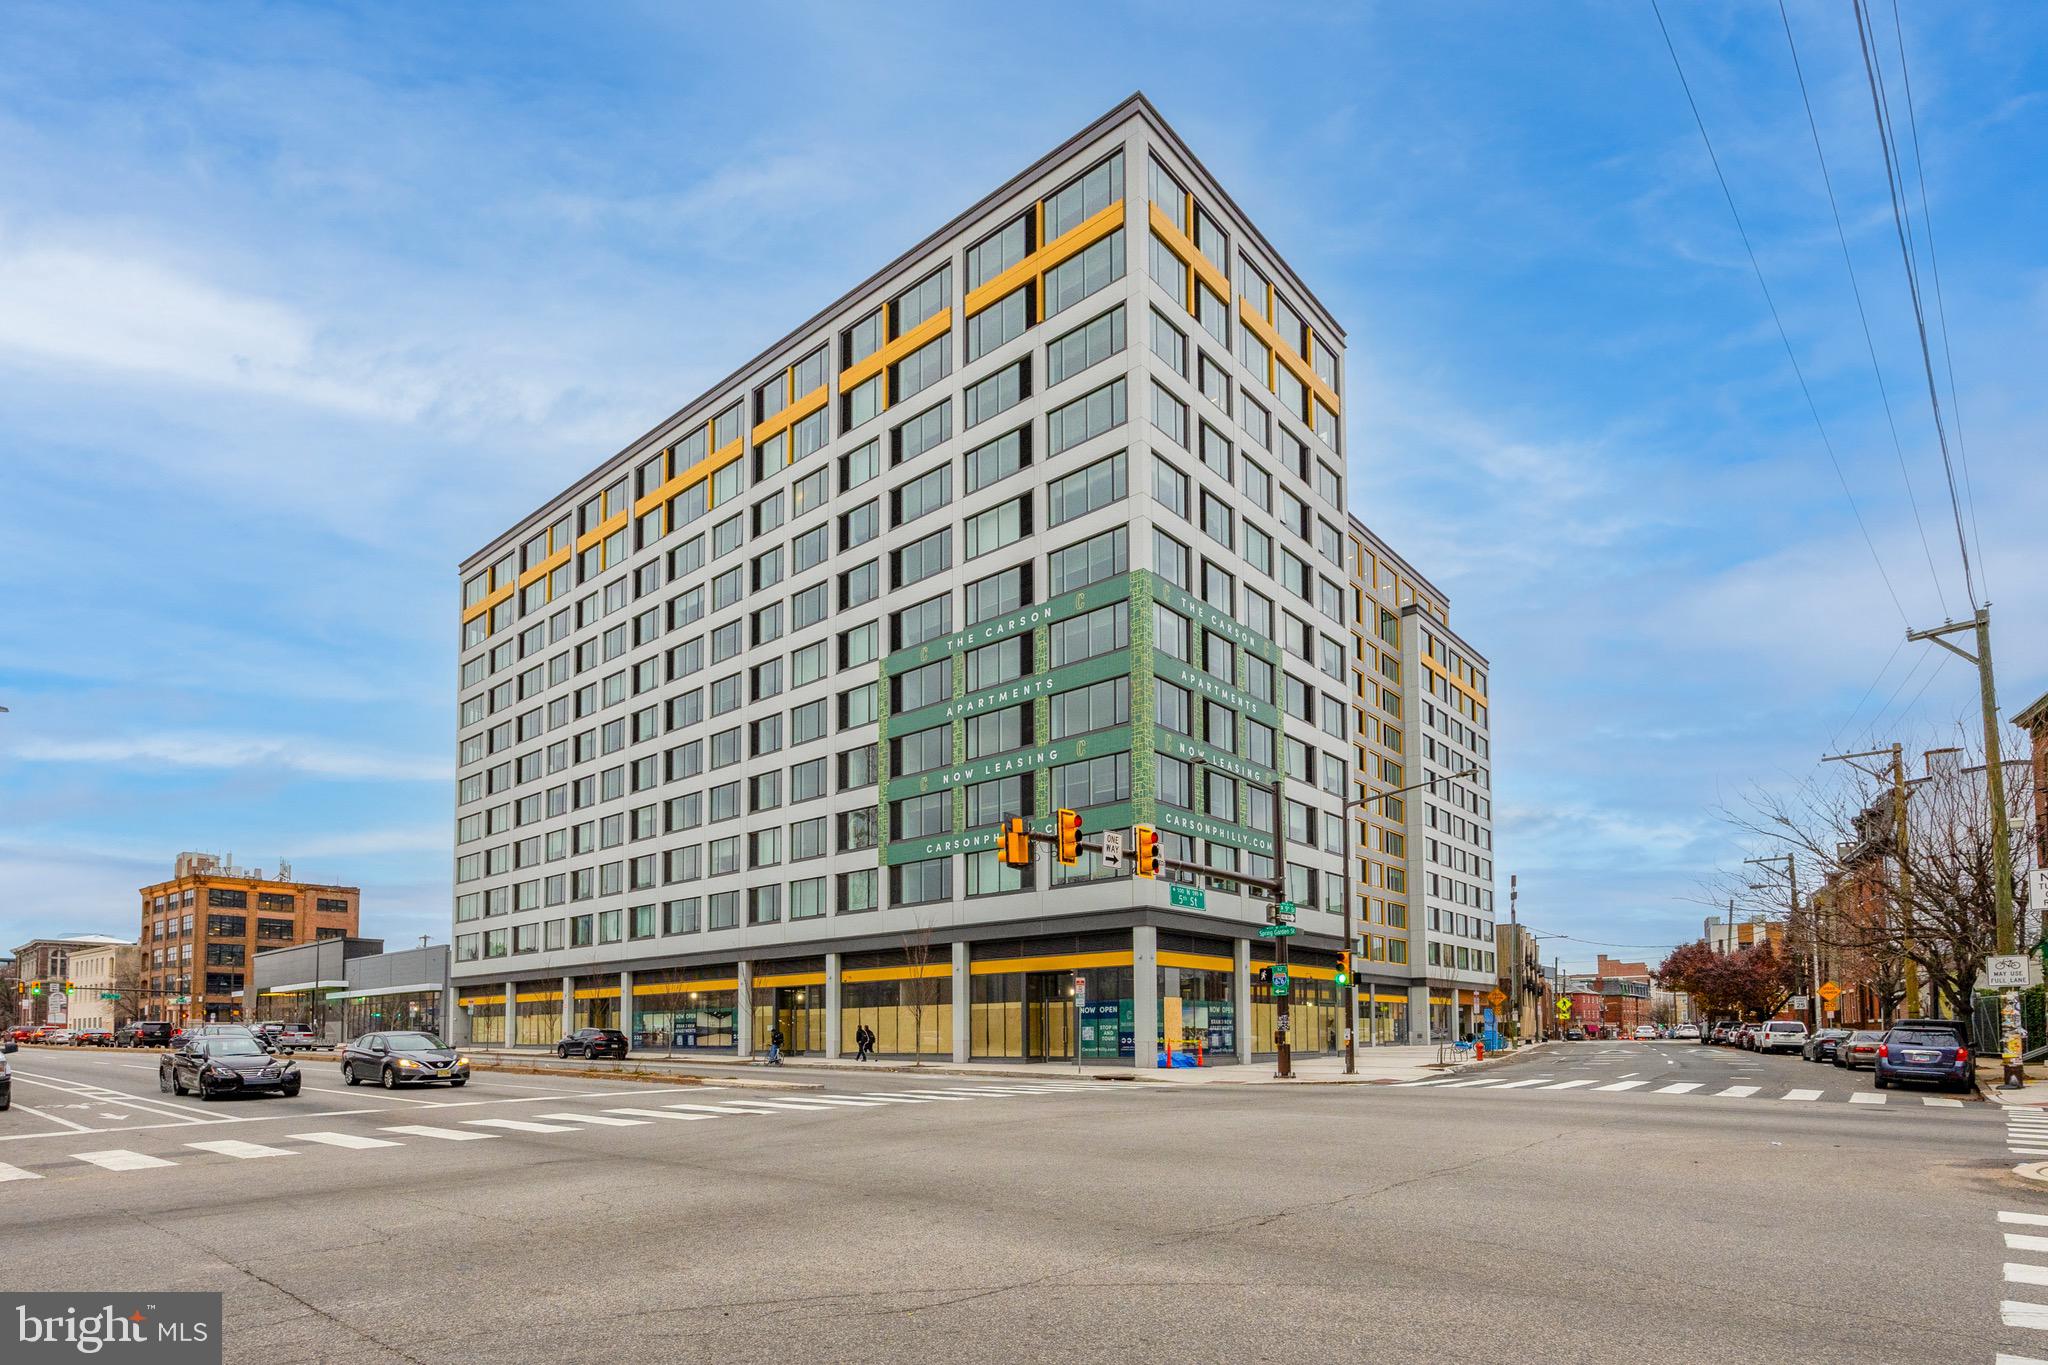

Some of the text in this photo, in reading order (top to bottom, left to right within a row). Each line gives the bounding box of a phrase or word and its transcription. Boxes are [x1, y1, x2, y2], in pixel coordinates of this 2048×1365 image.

[947, 634, 974, 650] THE
[985, 607, 1051, 637] CARSON
[1181, 598, 1203, 617] THE
[1211, 615, 1255, 646] CARSON
[946, 678, 1053, 717] APARTMENTS
[1181, 670, 1257, 713] APARTMENTS
[943, 768, 974, 784] NOW
[985, 750, 1058, 775] LEASING
[1179, 743, 1205, 757] NOW
[1212, 755, 1260, 781] LEASING
[1106, 834, 1119, 844] ONE
[1106, 844, 1119, 854] WAY
[1165, 813, 1273, 851] CARSONPHILLY.COM
[2041, 873, 2048, 881] N
[1190, 896, 1198, 907] St
